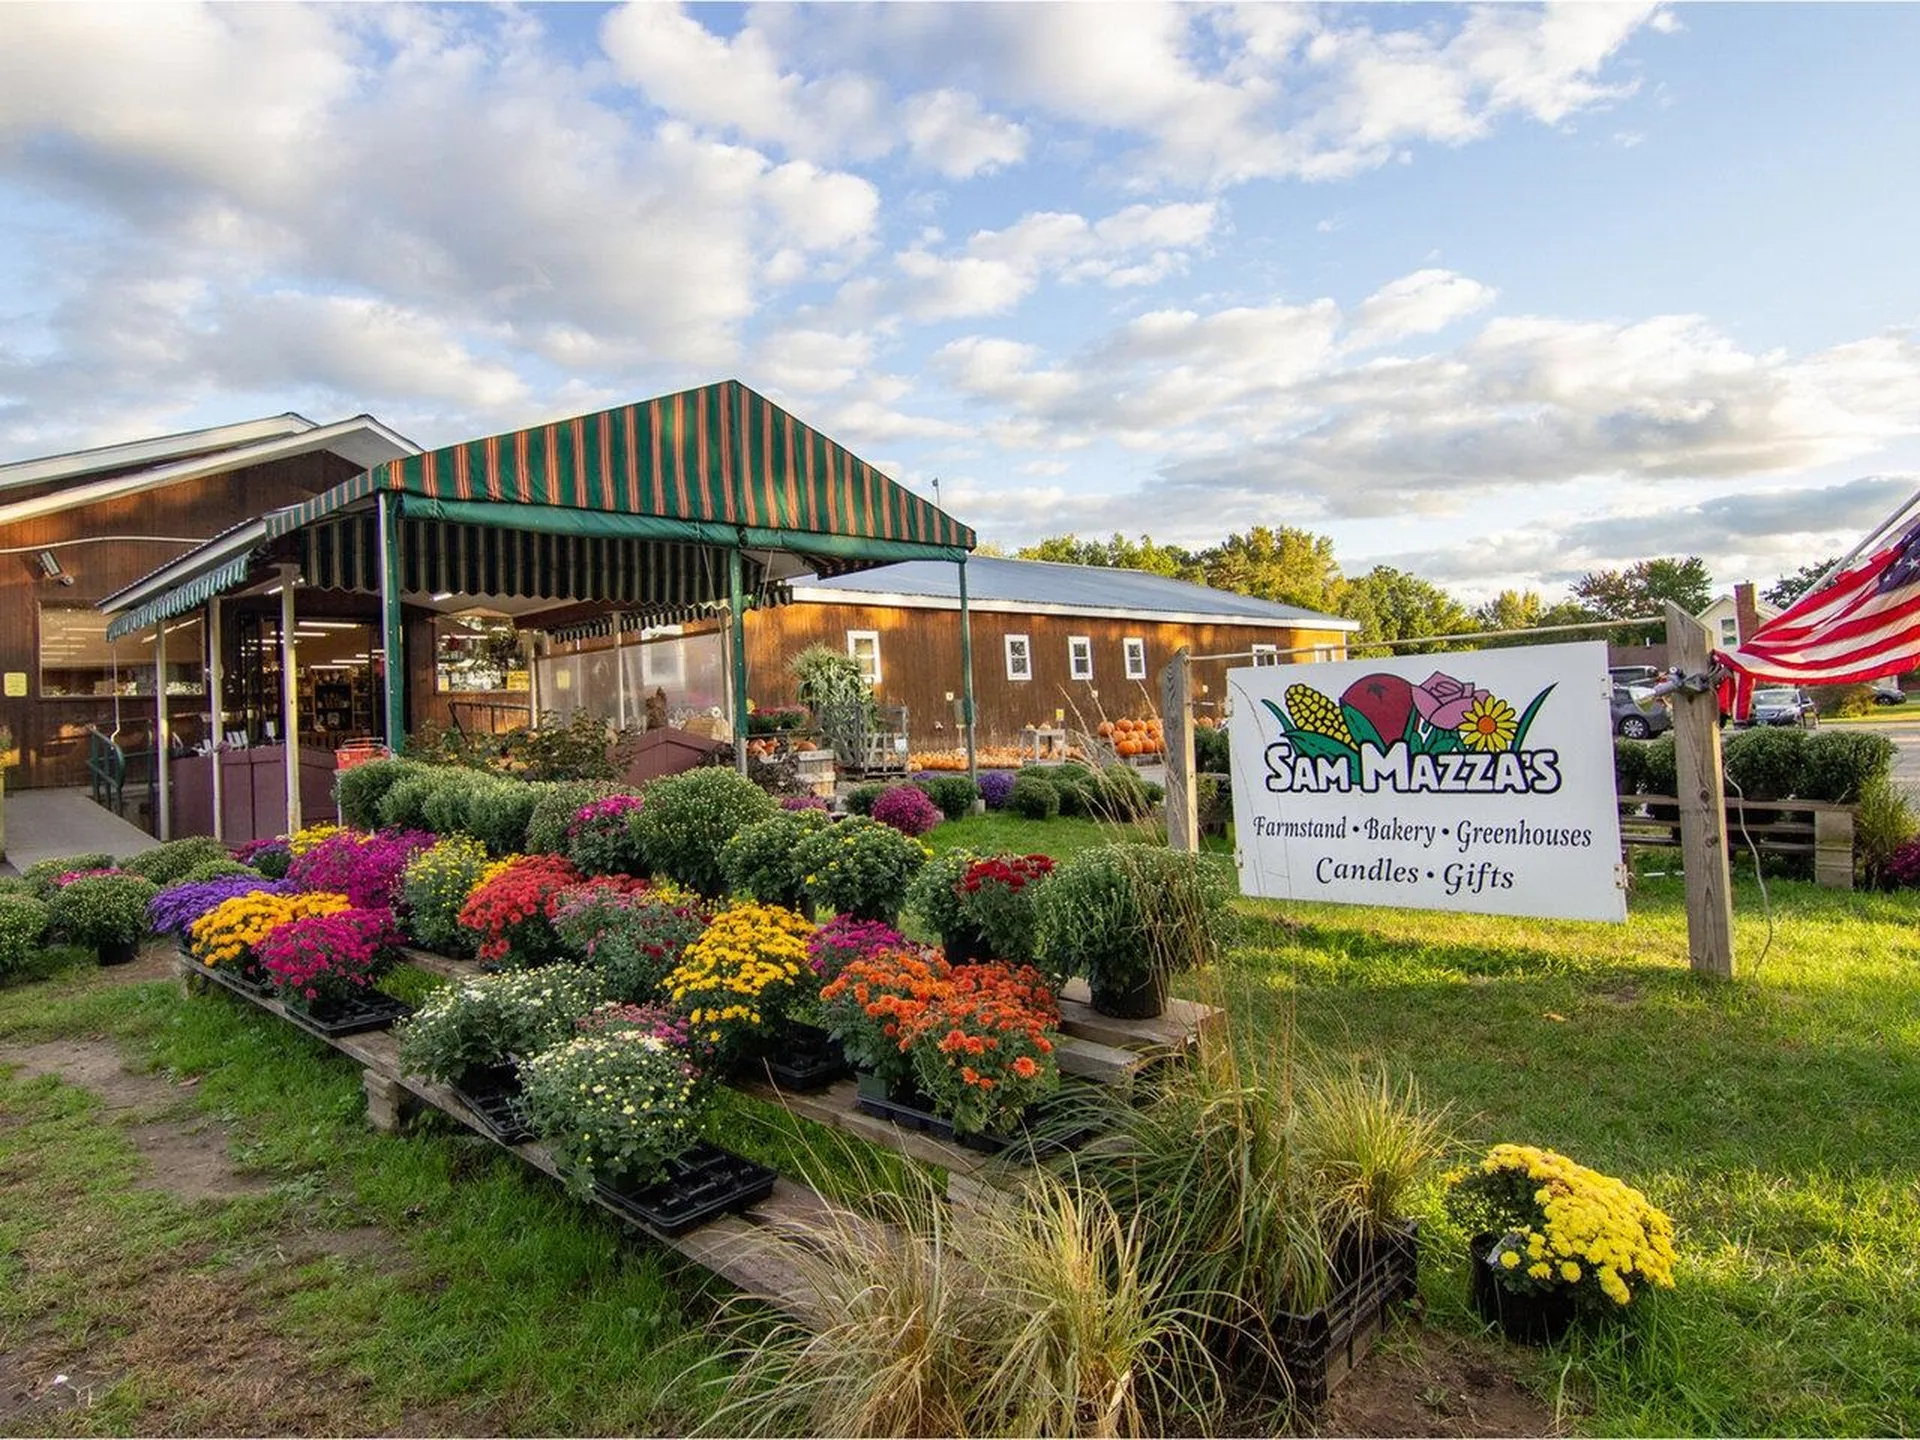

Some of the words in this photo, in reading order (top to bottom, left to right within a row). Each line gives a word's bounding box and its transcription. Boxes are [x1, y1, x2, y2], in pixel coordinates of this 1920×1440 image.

[1265, 742, 1352, 793] SAM
[1361, 739, 1562, 794] MAZZA'S
[1253, 815, 1347, 839] Farmstand
[1364, 816, 1436, 848] Bakery
[1457, 819, 1592, 853] Greenhouses
[1316, 857, 1419, 884] Candles
[1444, 862, 1514, 895] Gifts
